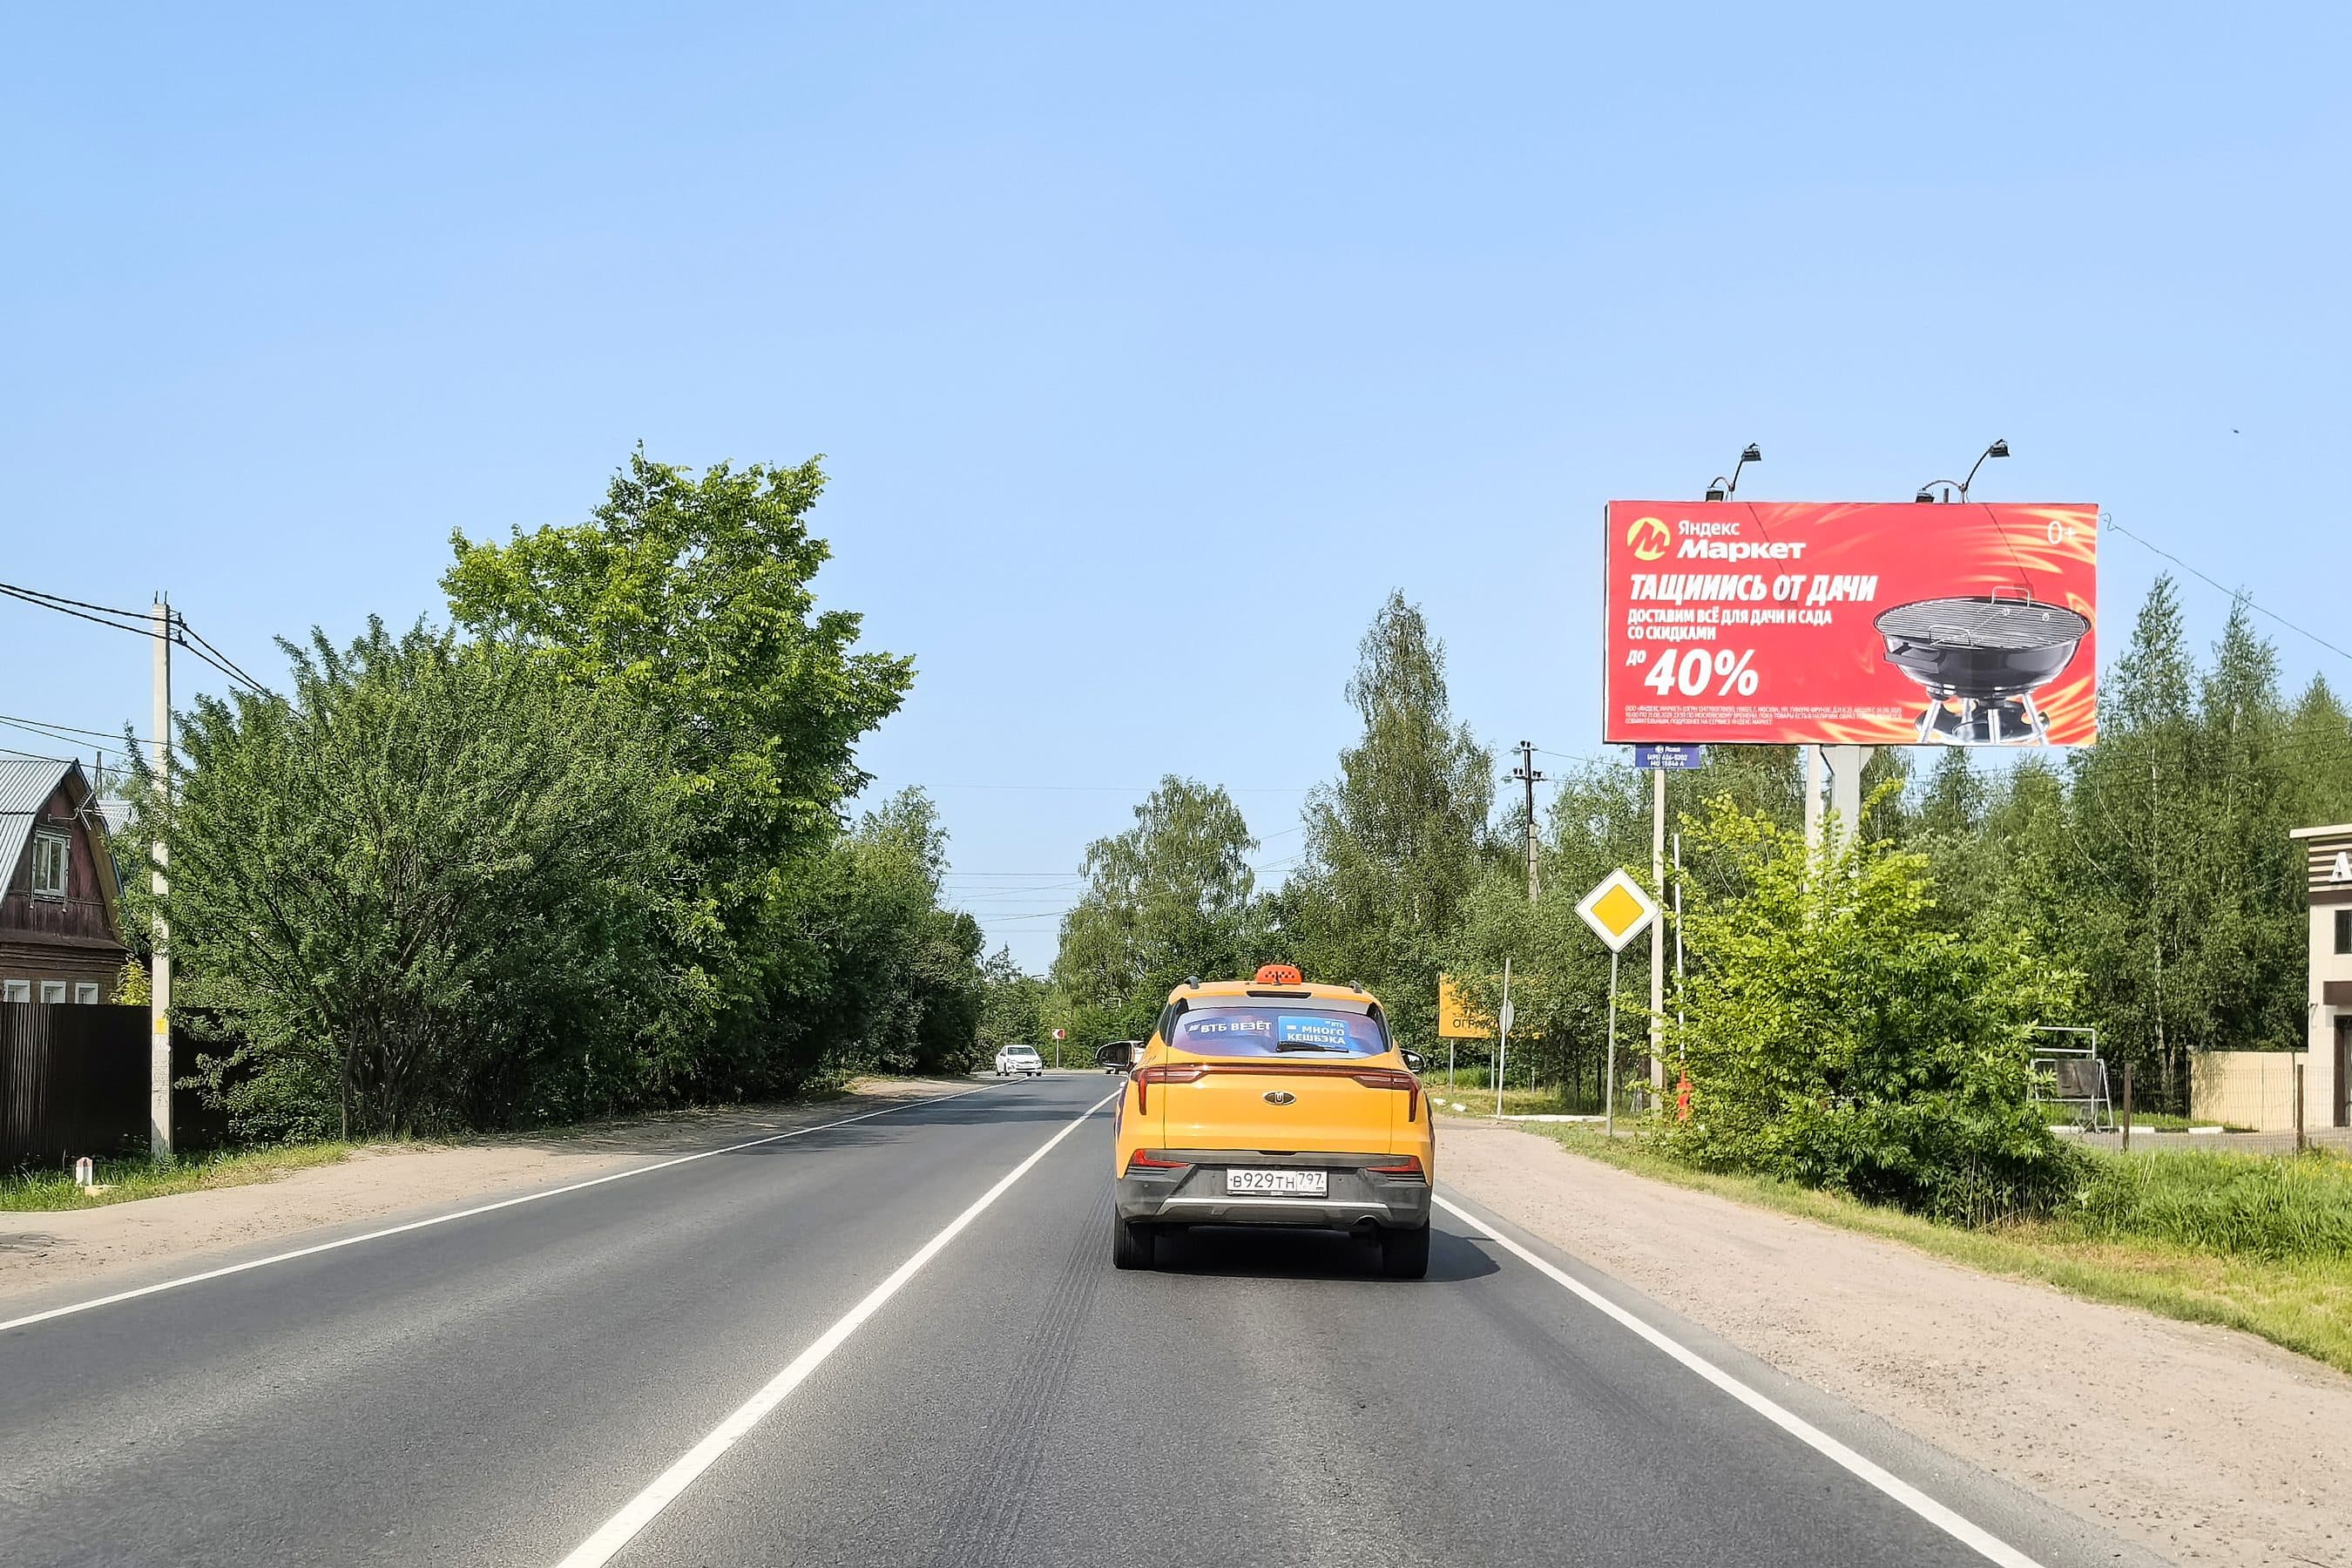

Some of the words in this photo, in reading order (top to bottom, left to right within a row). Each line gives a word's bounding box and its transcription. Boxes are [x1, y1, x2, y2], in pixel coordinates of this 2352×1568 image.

[1678, 520, 1740, 537] Яндекс
[2047, 521, 2077, 544] 0+
[1677, 539, 1806, 562] Маркет
[1630, 574, 1767, 605] ТАЩИИИСЬ
[1772, 575, 1807, 601] ОТ
[1806, 575, 1878, 606] ДАЧИ
[1626, 609, 1695, 625] ДОСТАВИМ
[1697, 606, 1720, 624] ВСЁ
[1720, 610, 1749, 625] ДЛЯ
[1750, 610, 1785, 626] ДАЧИ
[1786, 610, 1796, 624] И
[1798, 610, 1833, 625] САДА
[1626, 625, 1645, 640] СО
[1646, 626, 1716, 643] СКИДКАМИ
[1644, 647, 1760, 697] 40%
[1201, 1023, 1227, 1034] ВТБ
[1230, 1021, 1273, 1032] ВЕЗЁТ
[1301, 1025, 1345, 1036] МНОГО
[1287, 1032, 1346, 1045] КЕШБЭКА
[1297, 1173, 1322, 1186] 797
